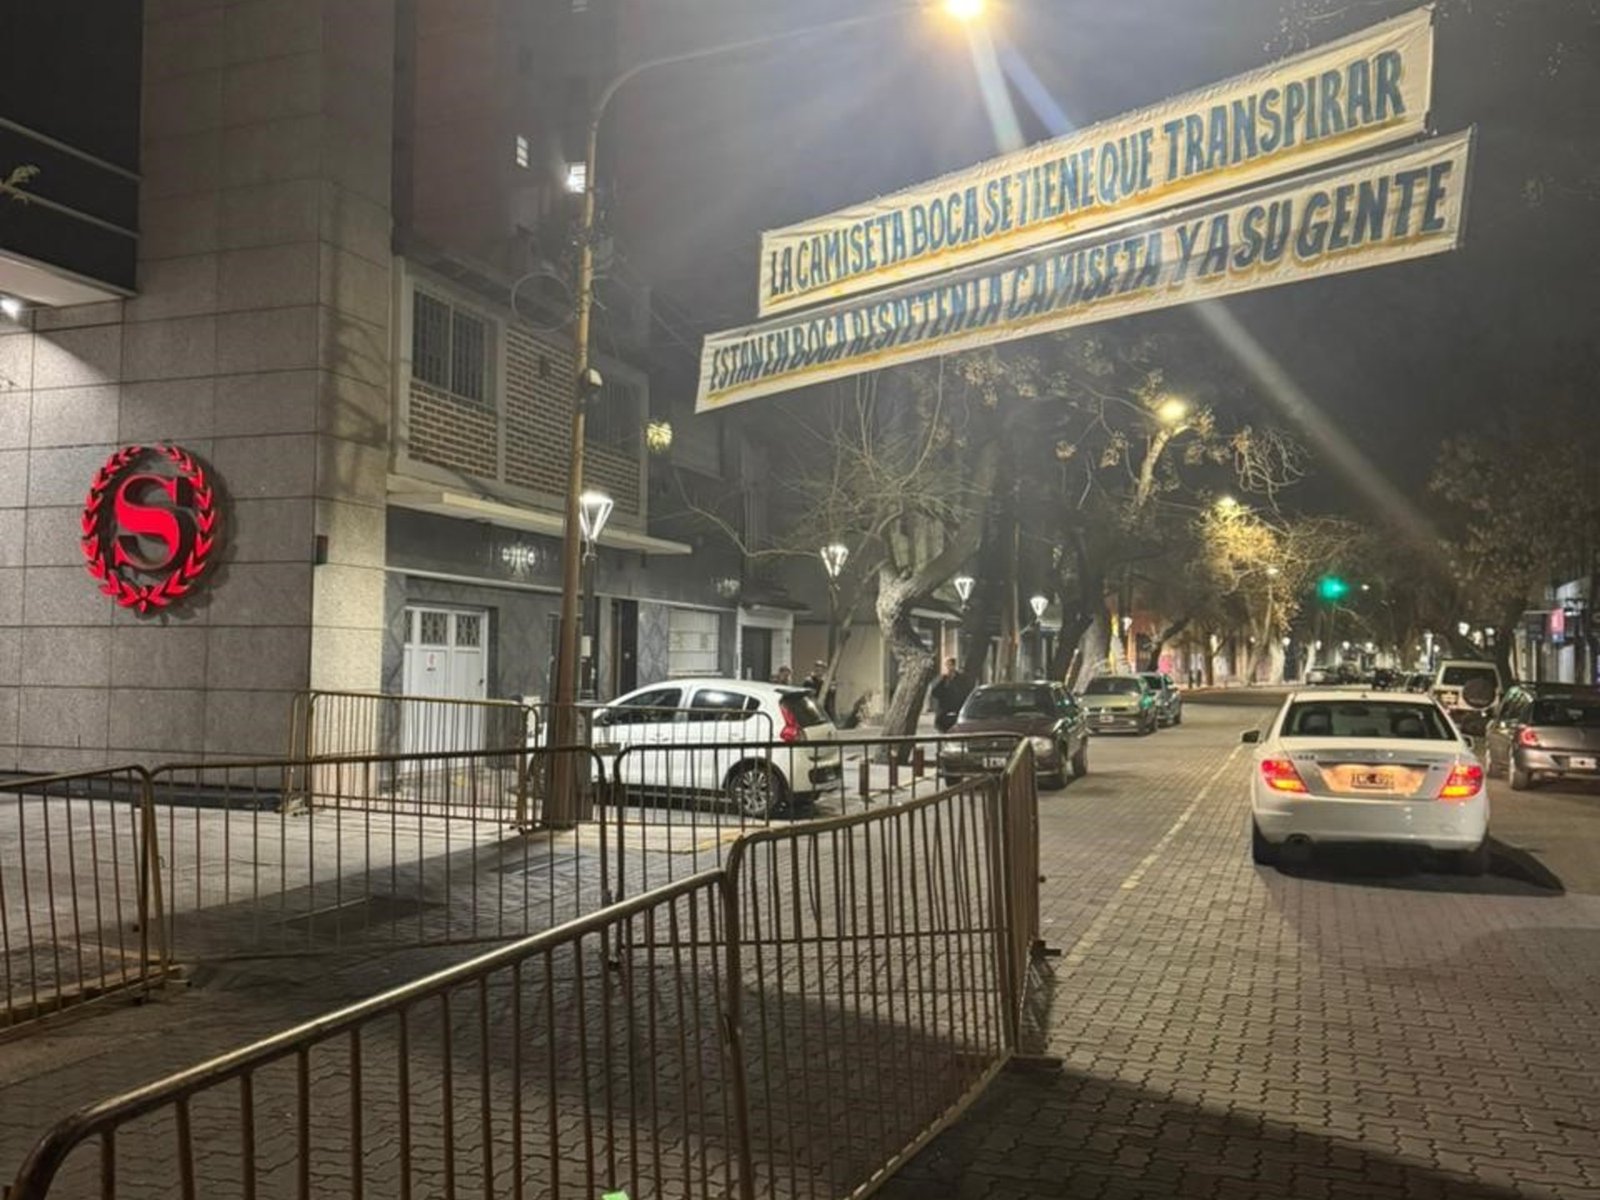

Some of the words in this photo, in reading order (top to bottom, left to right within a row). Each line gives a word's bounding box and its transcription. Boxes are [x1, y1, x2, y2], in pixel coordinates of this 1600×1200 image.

[709, 336, 763, 391] ESTAN
[762, 330, 789, 376] EN
[788, 313, 846, 369] BOCA
[1007, 231, 1162, 319] CAMISETA
[1174, 220, 1203, 281] Y
[1200, 214, 1230, 275] A
[1233, 201, 1292, 267] SU
[1297, 160, 1454, 258] GENTE
[770, 246, 793, 296] LA
[798, 210, 905, 285] CAMISETA
[912, 188, 979, 254] BOCA
[984, 179, 1013, 236] SE
[1015, 147, 1094, 224] TIENE
[1099, 128, 1153, 203] QUE
[1163, 51, 1405, 181] TRANSPIRAR
[114, 473, 181, 571] S
